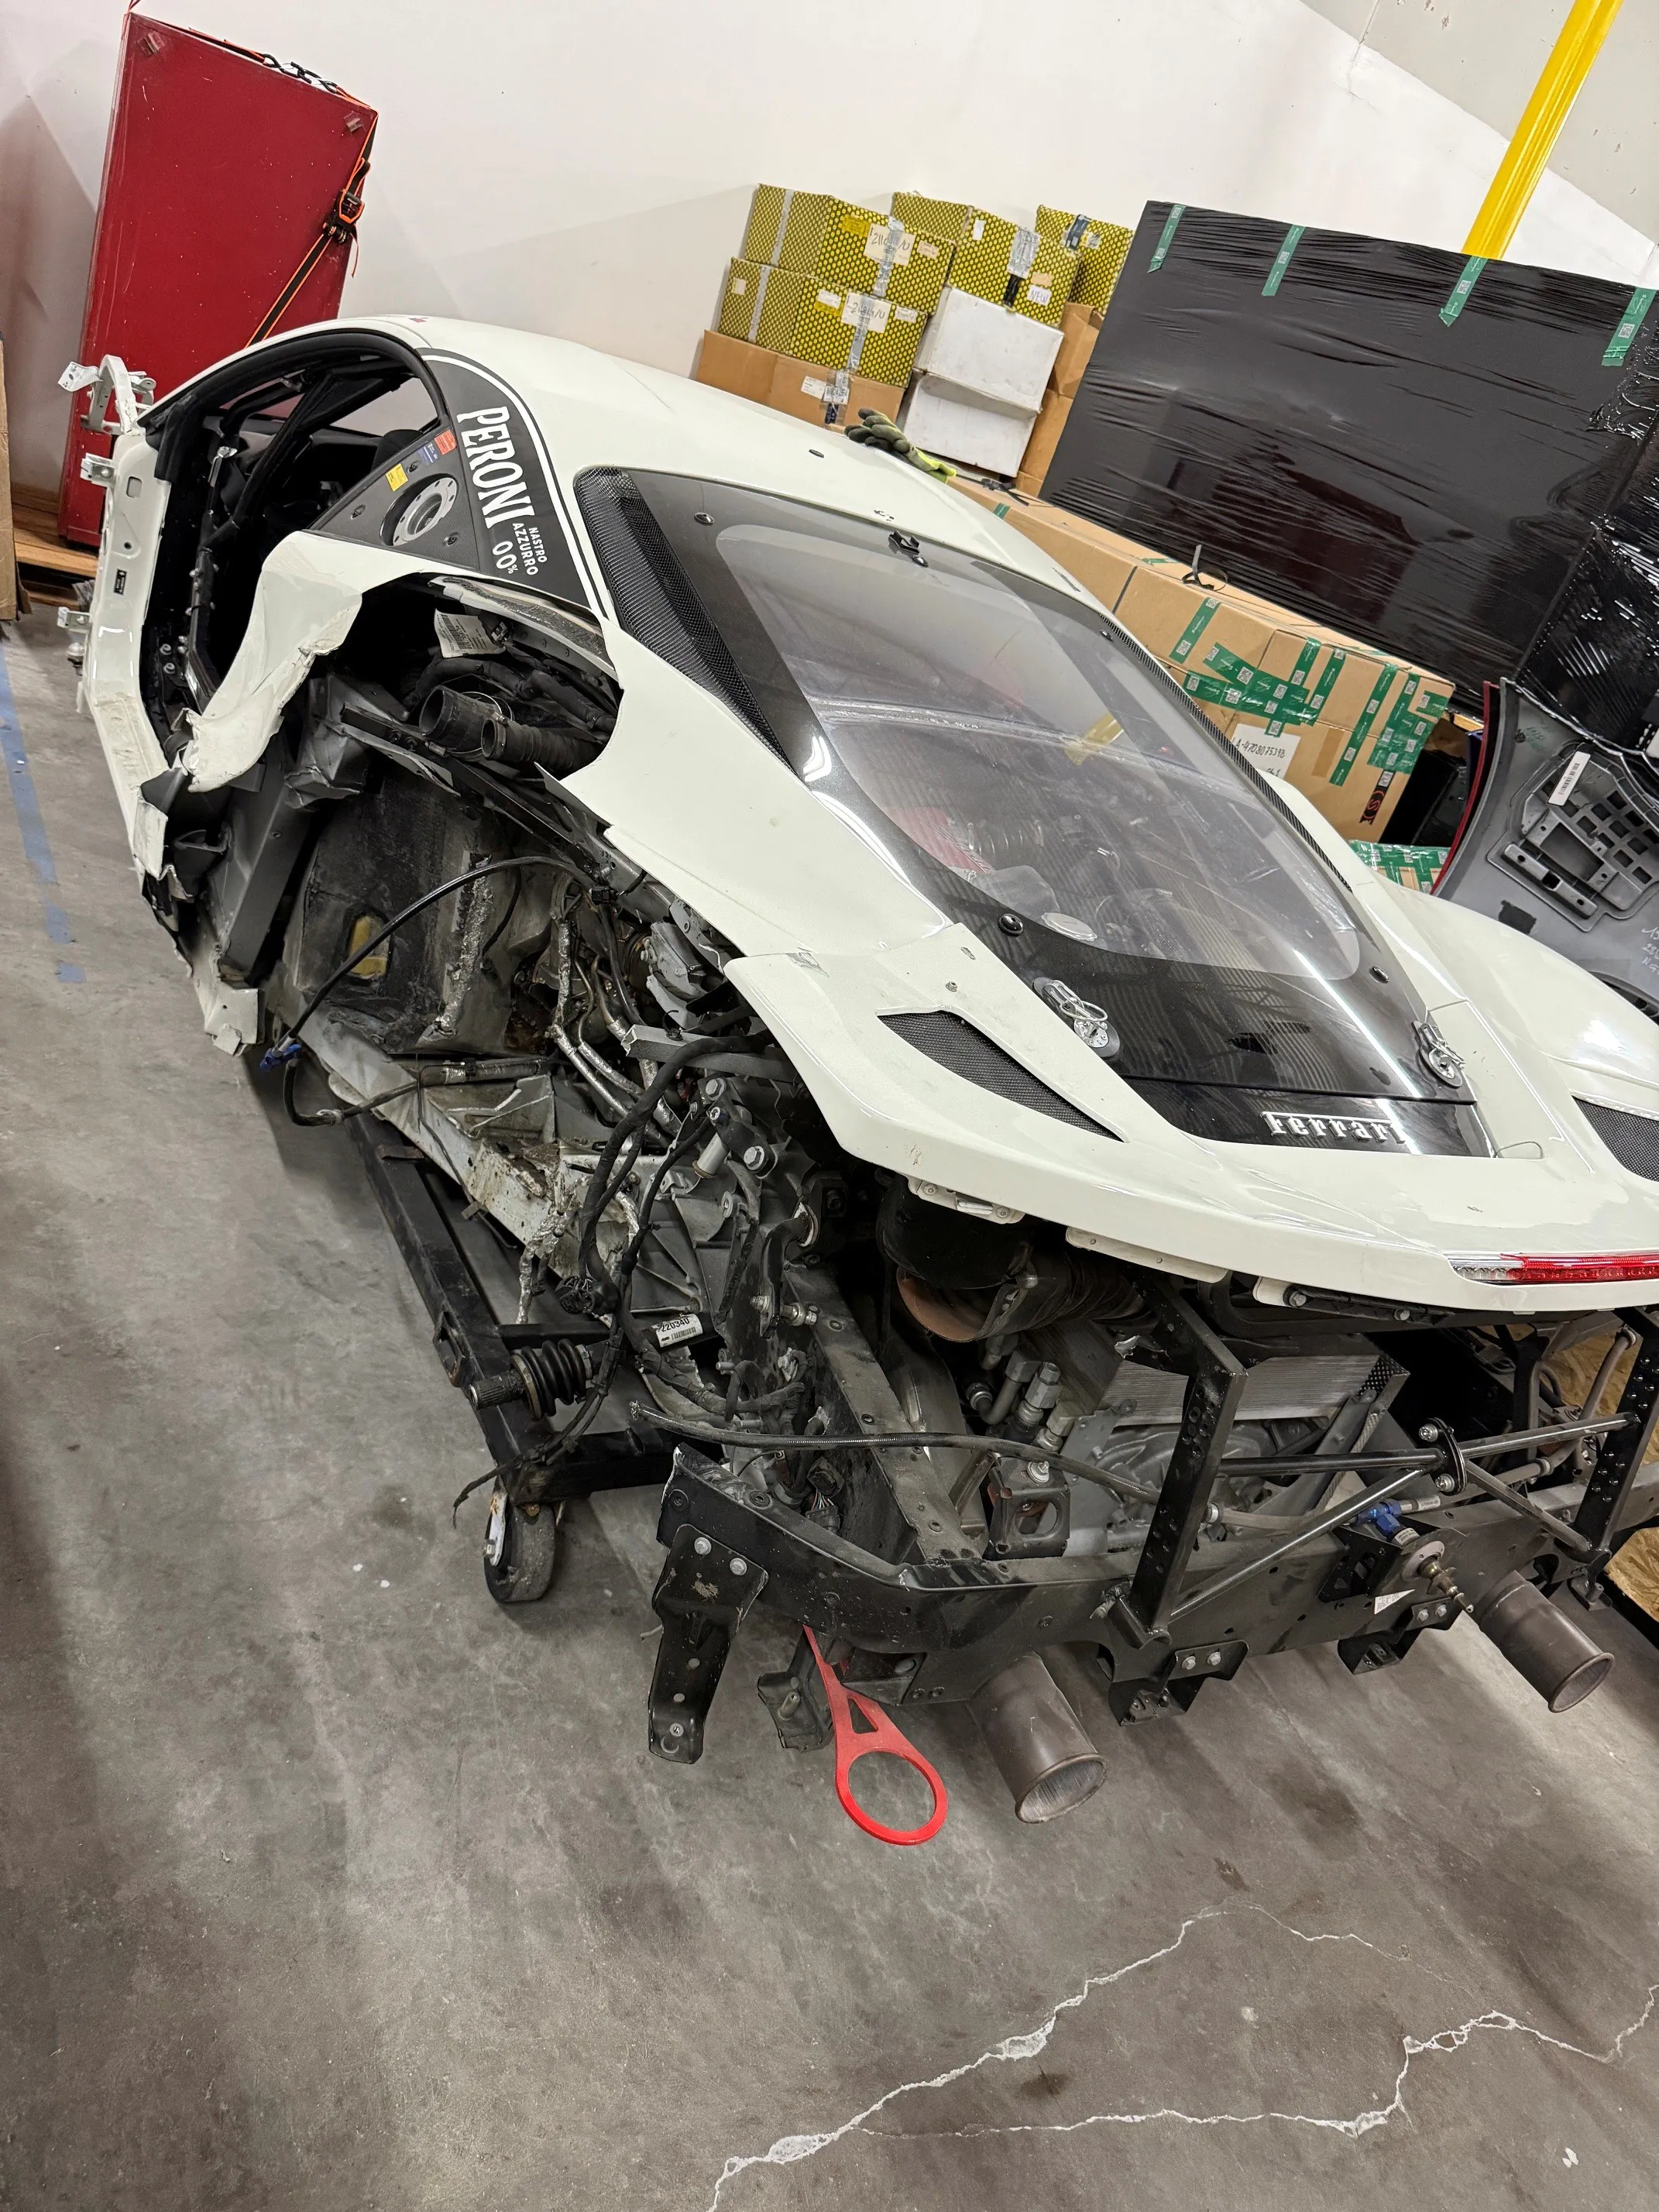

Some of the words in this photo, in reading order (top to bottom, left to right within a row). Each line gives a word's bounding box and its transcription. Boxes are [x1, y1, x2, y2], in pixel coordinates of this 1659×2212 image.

[1029, 290, 1049, 303] NEW
[456, 406, 535, 529] PERONI
[512, 522, 539, 575] AZZURRO
[528, 527, 548, 563] NASTRO
[1260, 1111, 1407, 1144] Ferrari
